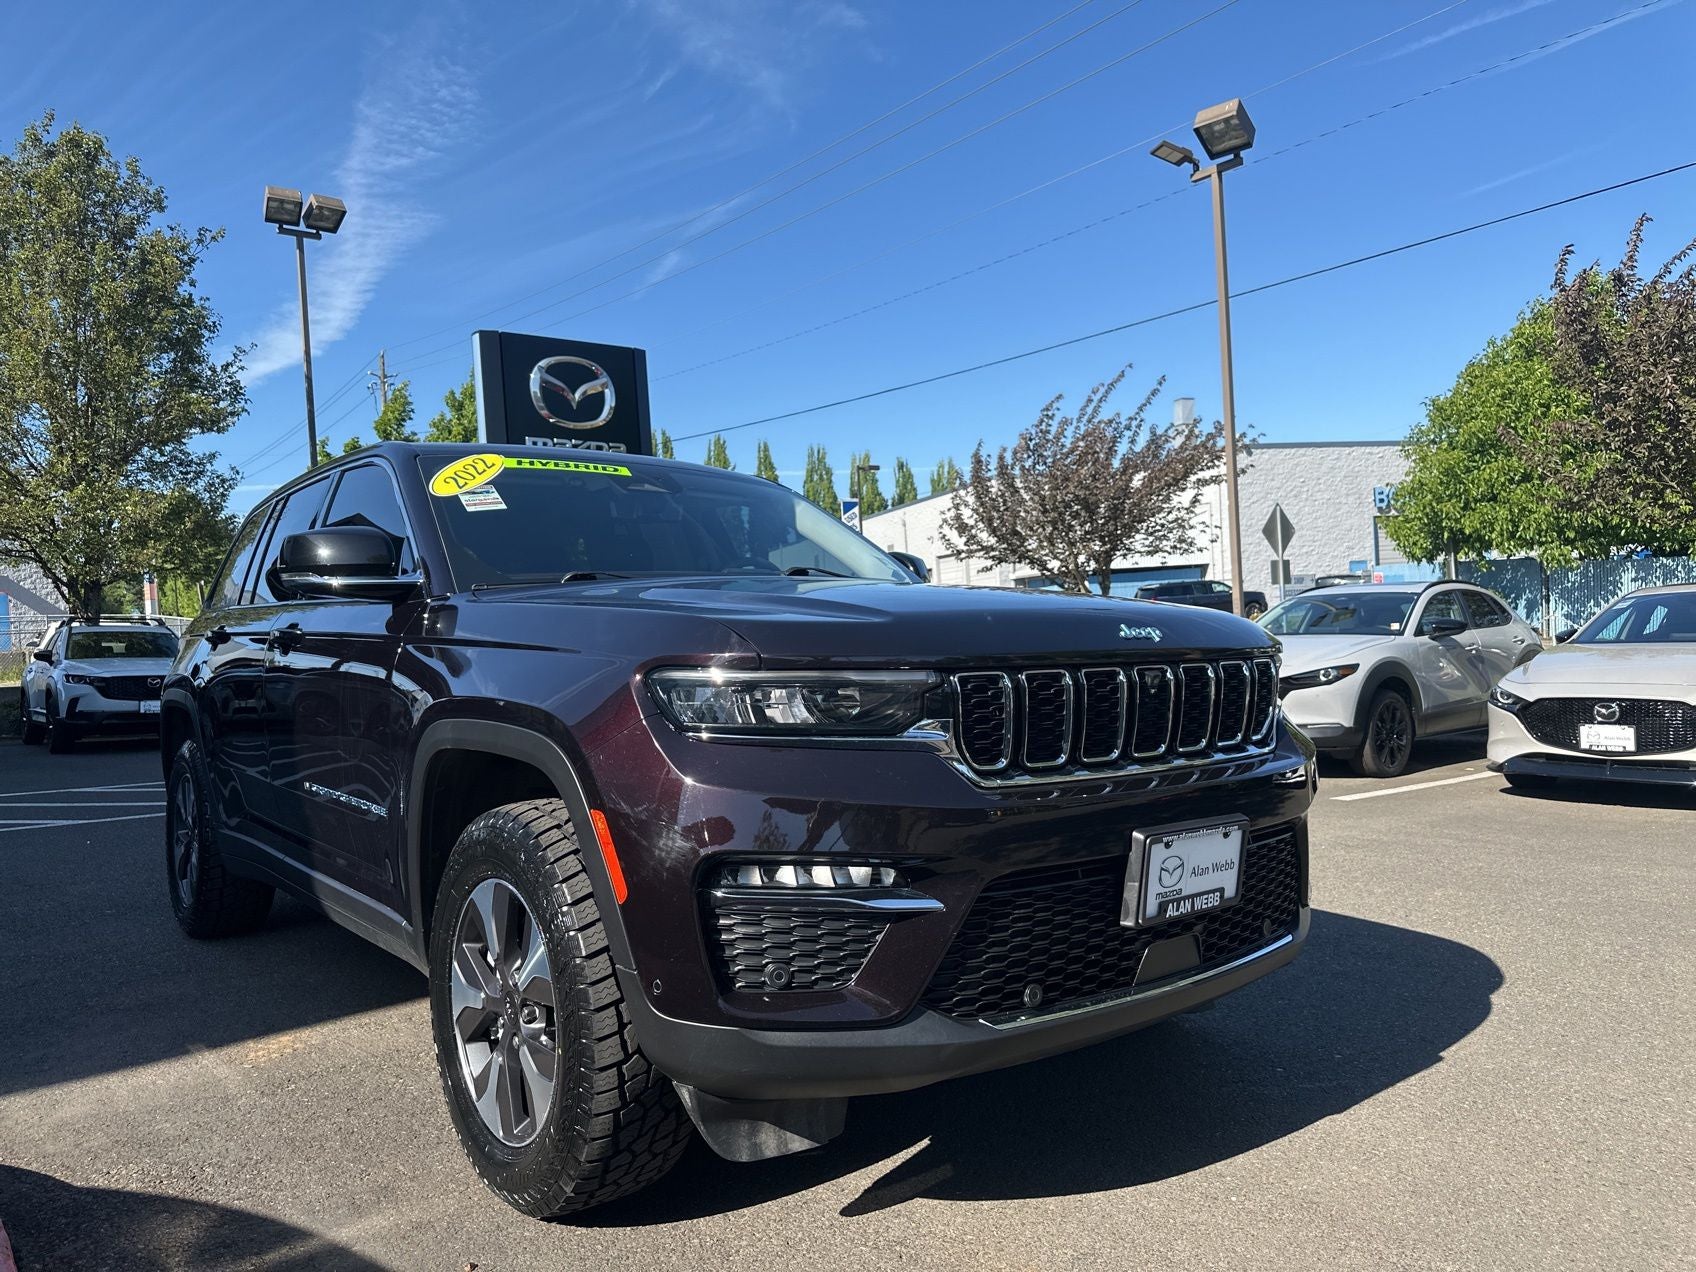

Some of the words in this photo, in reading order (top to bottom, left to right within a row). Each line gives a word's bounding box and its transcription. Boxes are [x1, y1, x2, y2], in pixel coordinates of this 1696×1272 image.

[443, 457, 495, 490] 2022
[516, 459, 619, 473] HYBRID
[1119, 623, 1163, 643] Jeep
[1189, 865, 1210, 879] Alan
[1211, 858, 1235, 873] Webb
[1155, 887, 1183, 901] mazda
[1166, 899, 1192, 918] ALAN
[1194, 891, 1221, 910] WEBB
